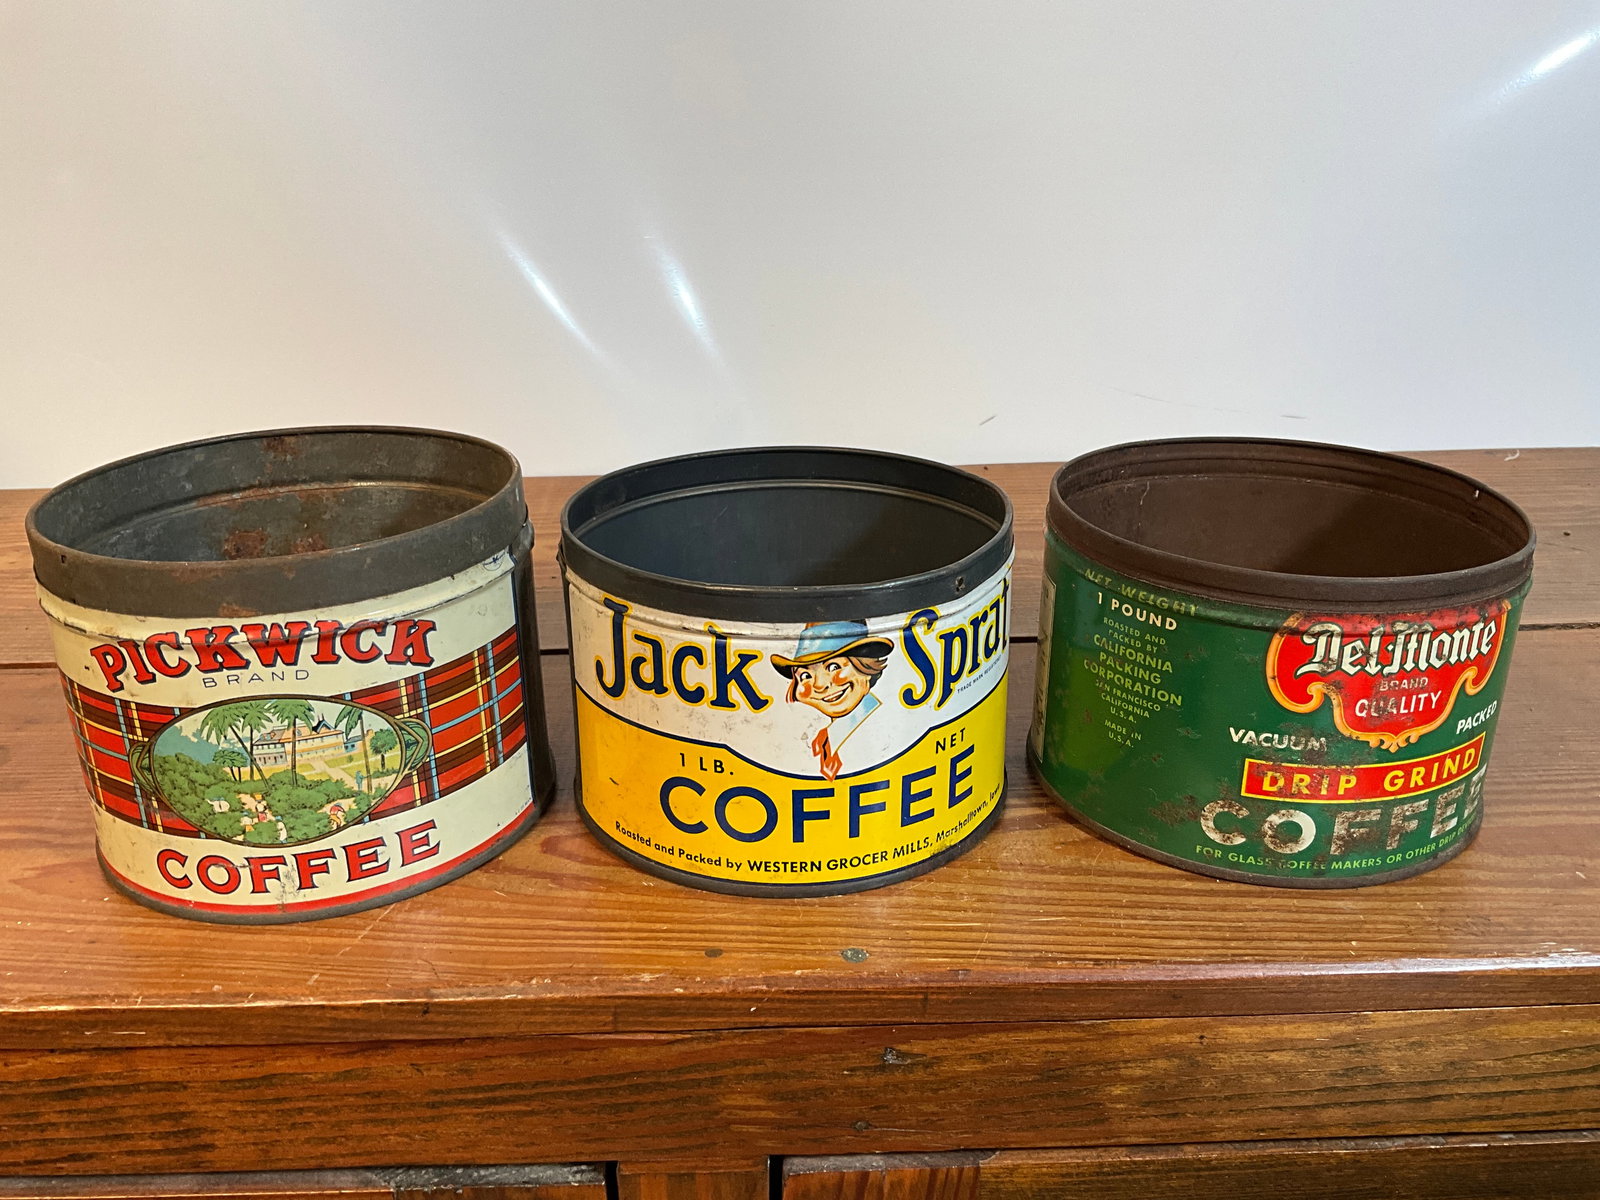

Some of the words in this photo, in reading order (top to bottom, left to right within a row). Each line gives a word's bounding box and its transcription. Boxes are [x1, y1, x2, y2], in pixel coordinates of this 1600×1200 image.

[1085, 568, 1112, 586] NET
[1121, 584, 1199, 616] WEIGHT
[1097, 591, 1103, 605] 1
[1111, 598, 1177, 631] POUND
[1103, 616, 1140, 637] ROASTED
[1144, 633, 1166, 645] AND
[1108, 629, 1142, 648] PACKED
[1146, 643, 1158, 654] BY
[1295, 622, 1382, 679] Del
[1383, 618, 1498, 677] Monte
[90, 619, 436, 692] PICKWICK
[595, 595, 770, 711] Jack
[1093, 634, 1173, 673] CALIFORNIA
[1099, 651, 1161, 684] PACKING
[203, 669, 310, 688] BRAND
[1083, 659, 1183, 706] CORPORATION
[1378, 677, 1429, 692] BRAND
[1101, 692, 1150, 718] CALIFORNIA
[1110, 706, 1137, 723] U.S.A.
[1113, 686, 1161, 712] FRANCISCO
[1355, 690, 1442, 717] QUALITY
[935, 727, 967, 754] NET
[1104, 719, 1127, 735] MADE
[1108, 730, 1134, 748] U.S.A.
[1229, 727, 1327, 751] VACUUM
[1456, 700, 1497, 735] PACKED
[680, 752, 686, 767] 1
[699, 756, 735, 776] LB.
[1262, 772, 1357, 796] DRIP
[1383, 747, 1477, 792] GRIND
[659, 744, 974, 843] COFFEE
[1200, 763, 1487, 855] COFFEE
[156, 818, 441, 895] COFFEE
[615, 820, 652, 847] Roasted
[654, 842, 675, 856] and
[678, 848, 722, 867] Packed
[726, 858, 743, 872] by
[747, 860, 822, 873] WESTERN
[827, 850, 888, 871] GROCER
[892, 836, 933, 860] MILLS,
[1196, 845, 1222, 858] FOR
[1228, 850, 1273, 867] GLASS
[1331, 855, 1382, 870] MAKERS
[1386, 853, 1402, 864] OR
[1405, 842, 1436, 859] OTHER
[1438, 831, 1457, 848] DRIP
